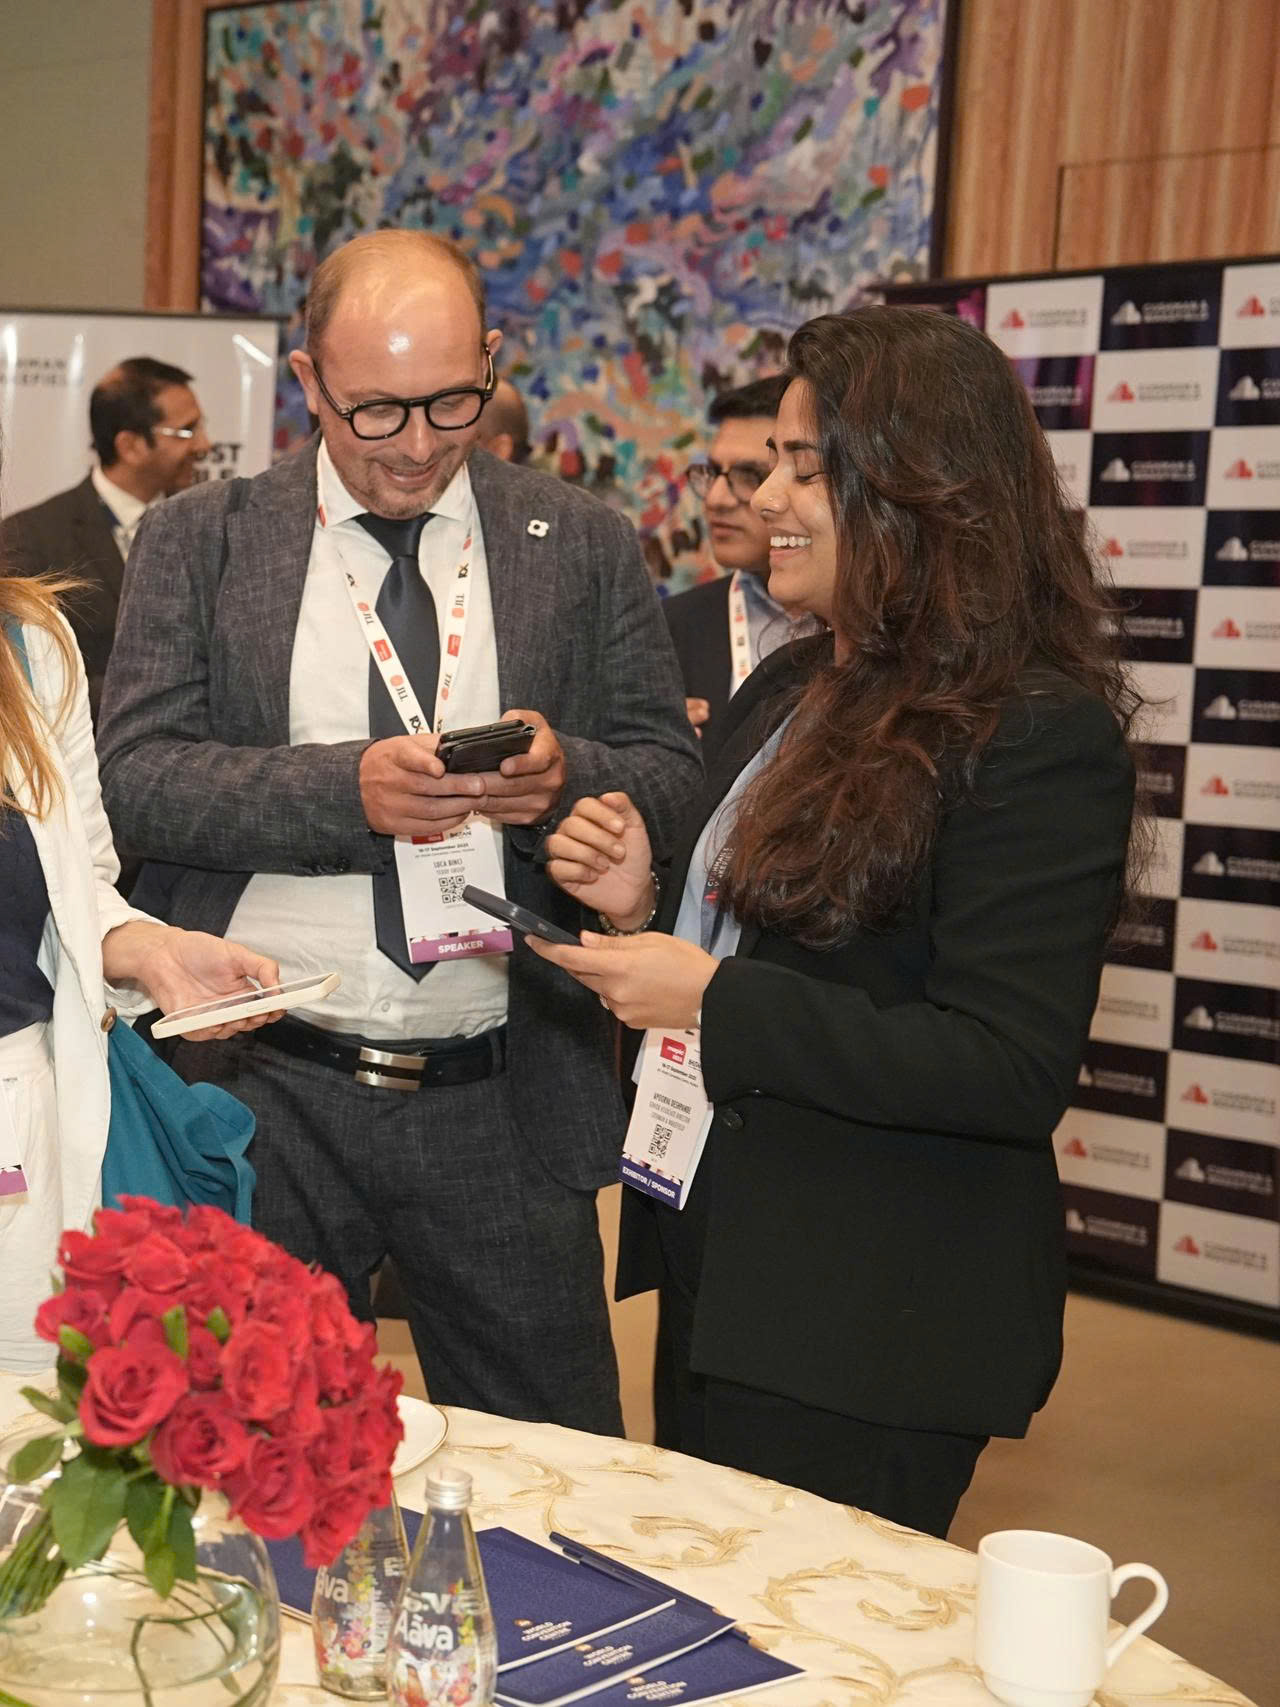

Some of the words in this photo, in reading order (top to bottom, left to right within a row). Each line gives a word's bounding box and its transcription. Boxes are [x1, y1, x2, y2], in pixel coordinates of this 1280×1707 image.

[396, 687, 409, 702] JLL
[438, 941, 485, 954] SPEAKER
[651, 1182, 676, 1199] SPONSOR
